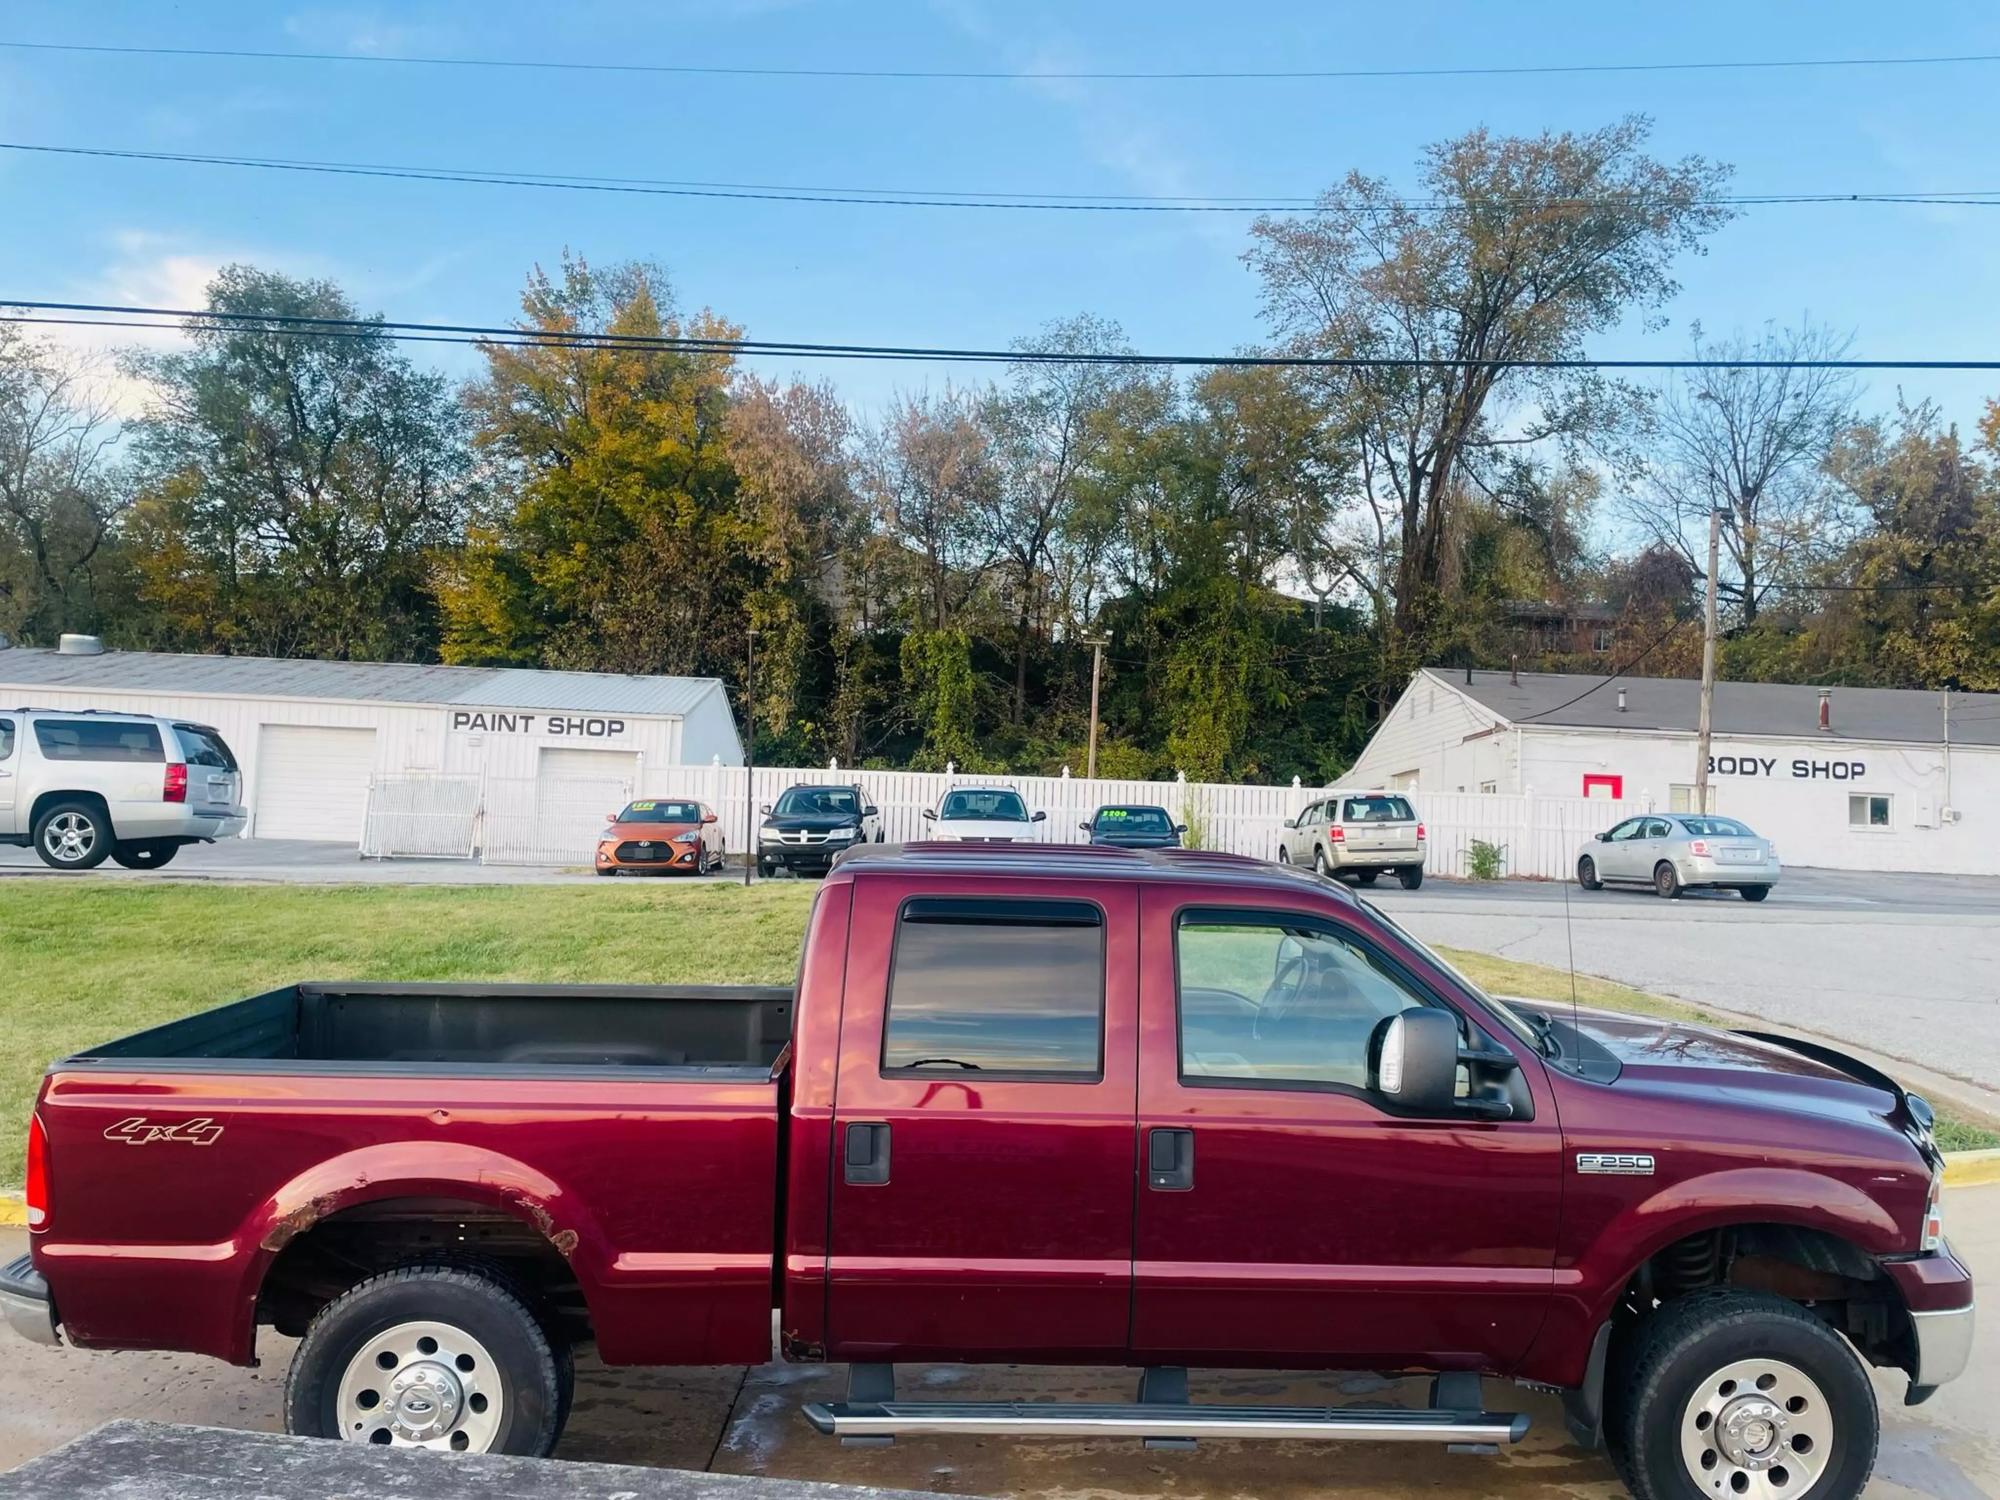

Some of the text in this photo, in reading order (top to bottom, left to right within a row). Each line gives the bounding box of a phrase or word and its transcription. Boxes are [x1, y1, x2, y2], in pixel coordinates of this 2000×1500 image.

[453, 712, 625, 737] PAINT SHOP
[1792, 760, 1866, 780] SHOP
